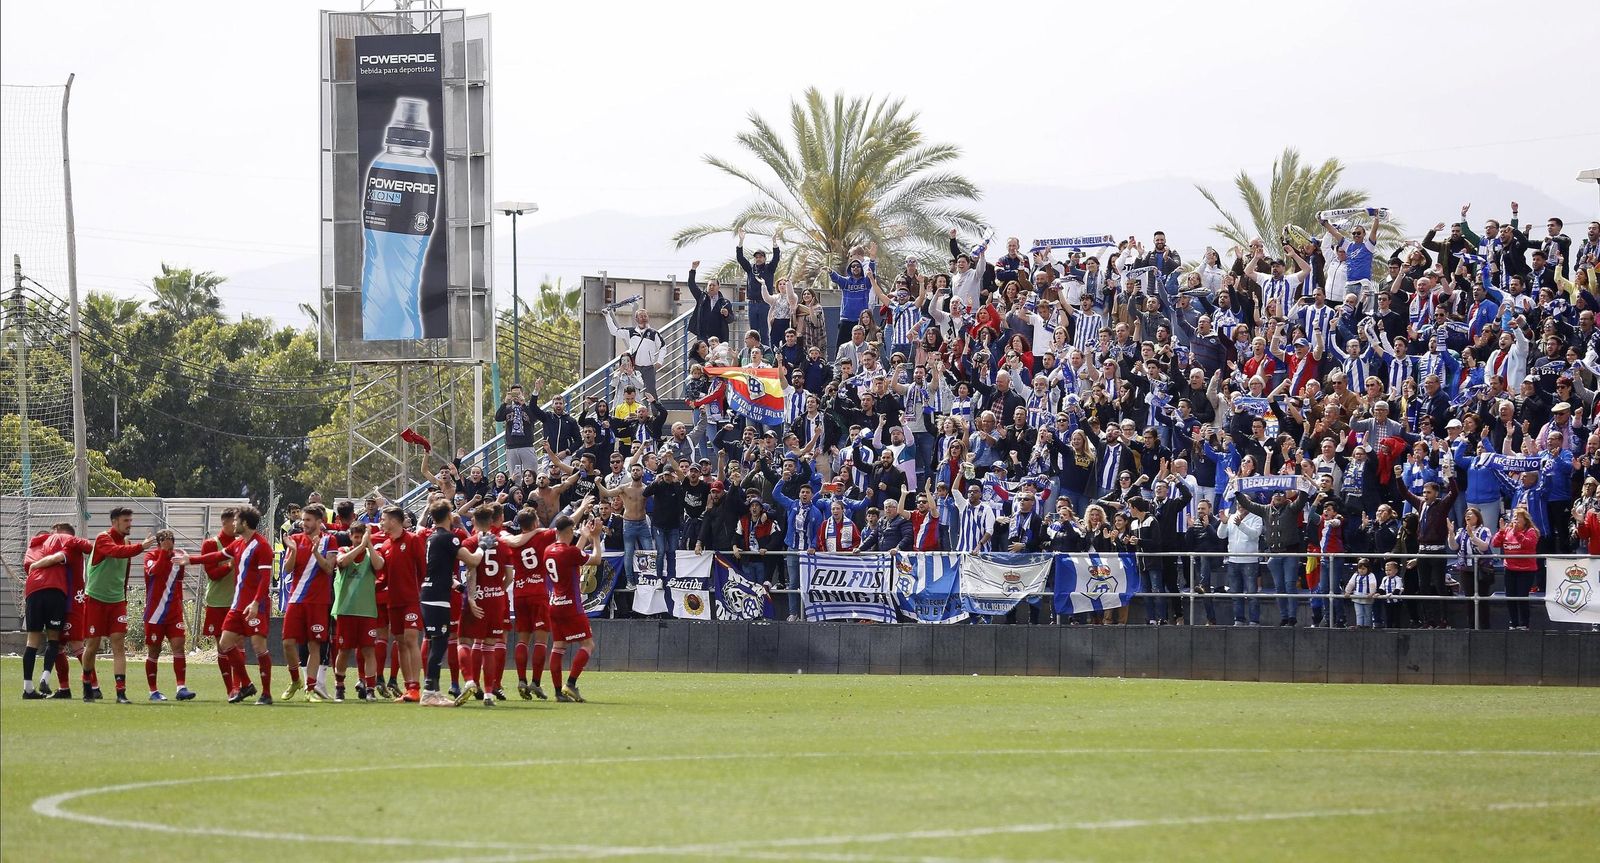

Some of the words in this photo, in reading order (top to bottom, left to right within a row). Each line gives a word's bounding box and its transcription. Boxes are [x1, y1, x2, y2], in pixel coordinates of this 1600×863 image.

[359, 53, 437, 65] POWERADE
[360, 67, 382, 75] bebida
[383, 67, 398, 75] para
[399, 66, 436, 74] deportistas
[368, 177, 436, 194] POWERADE
[1082, 236, 1102, 245] HUELVA
[1493, 457, 1539, 468] RECREATIVO
[1242, 477, 1292, 490] RECREATIVO
[485, 549, 499, 576] 5
[521, 547, 538, 569] 6
[546, 558, 559, 582] 9
[666, 578, 703, 589] Suicida
[810, 568, 884, 588] GOLFOS
